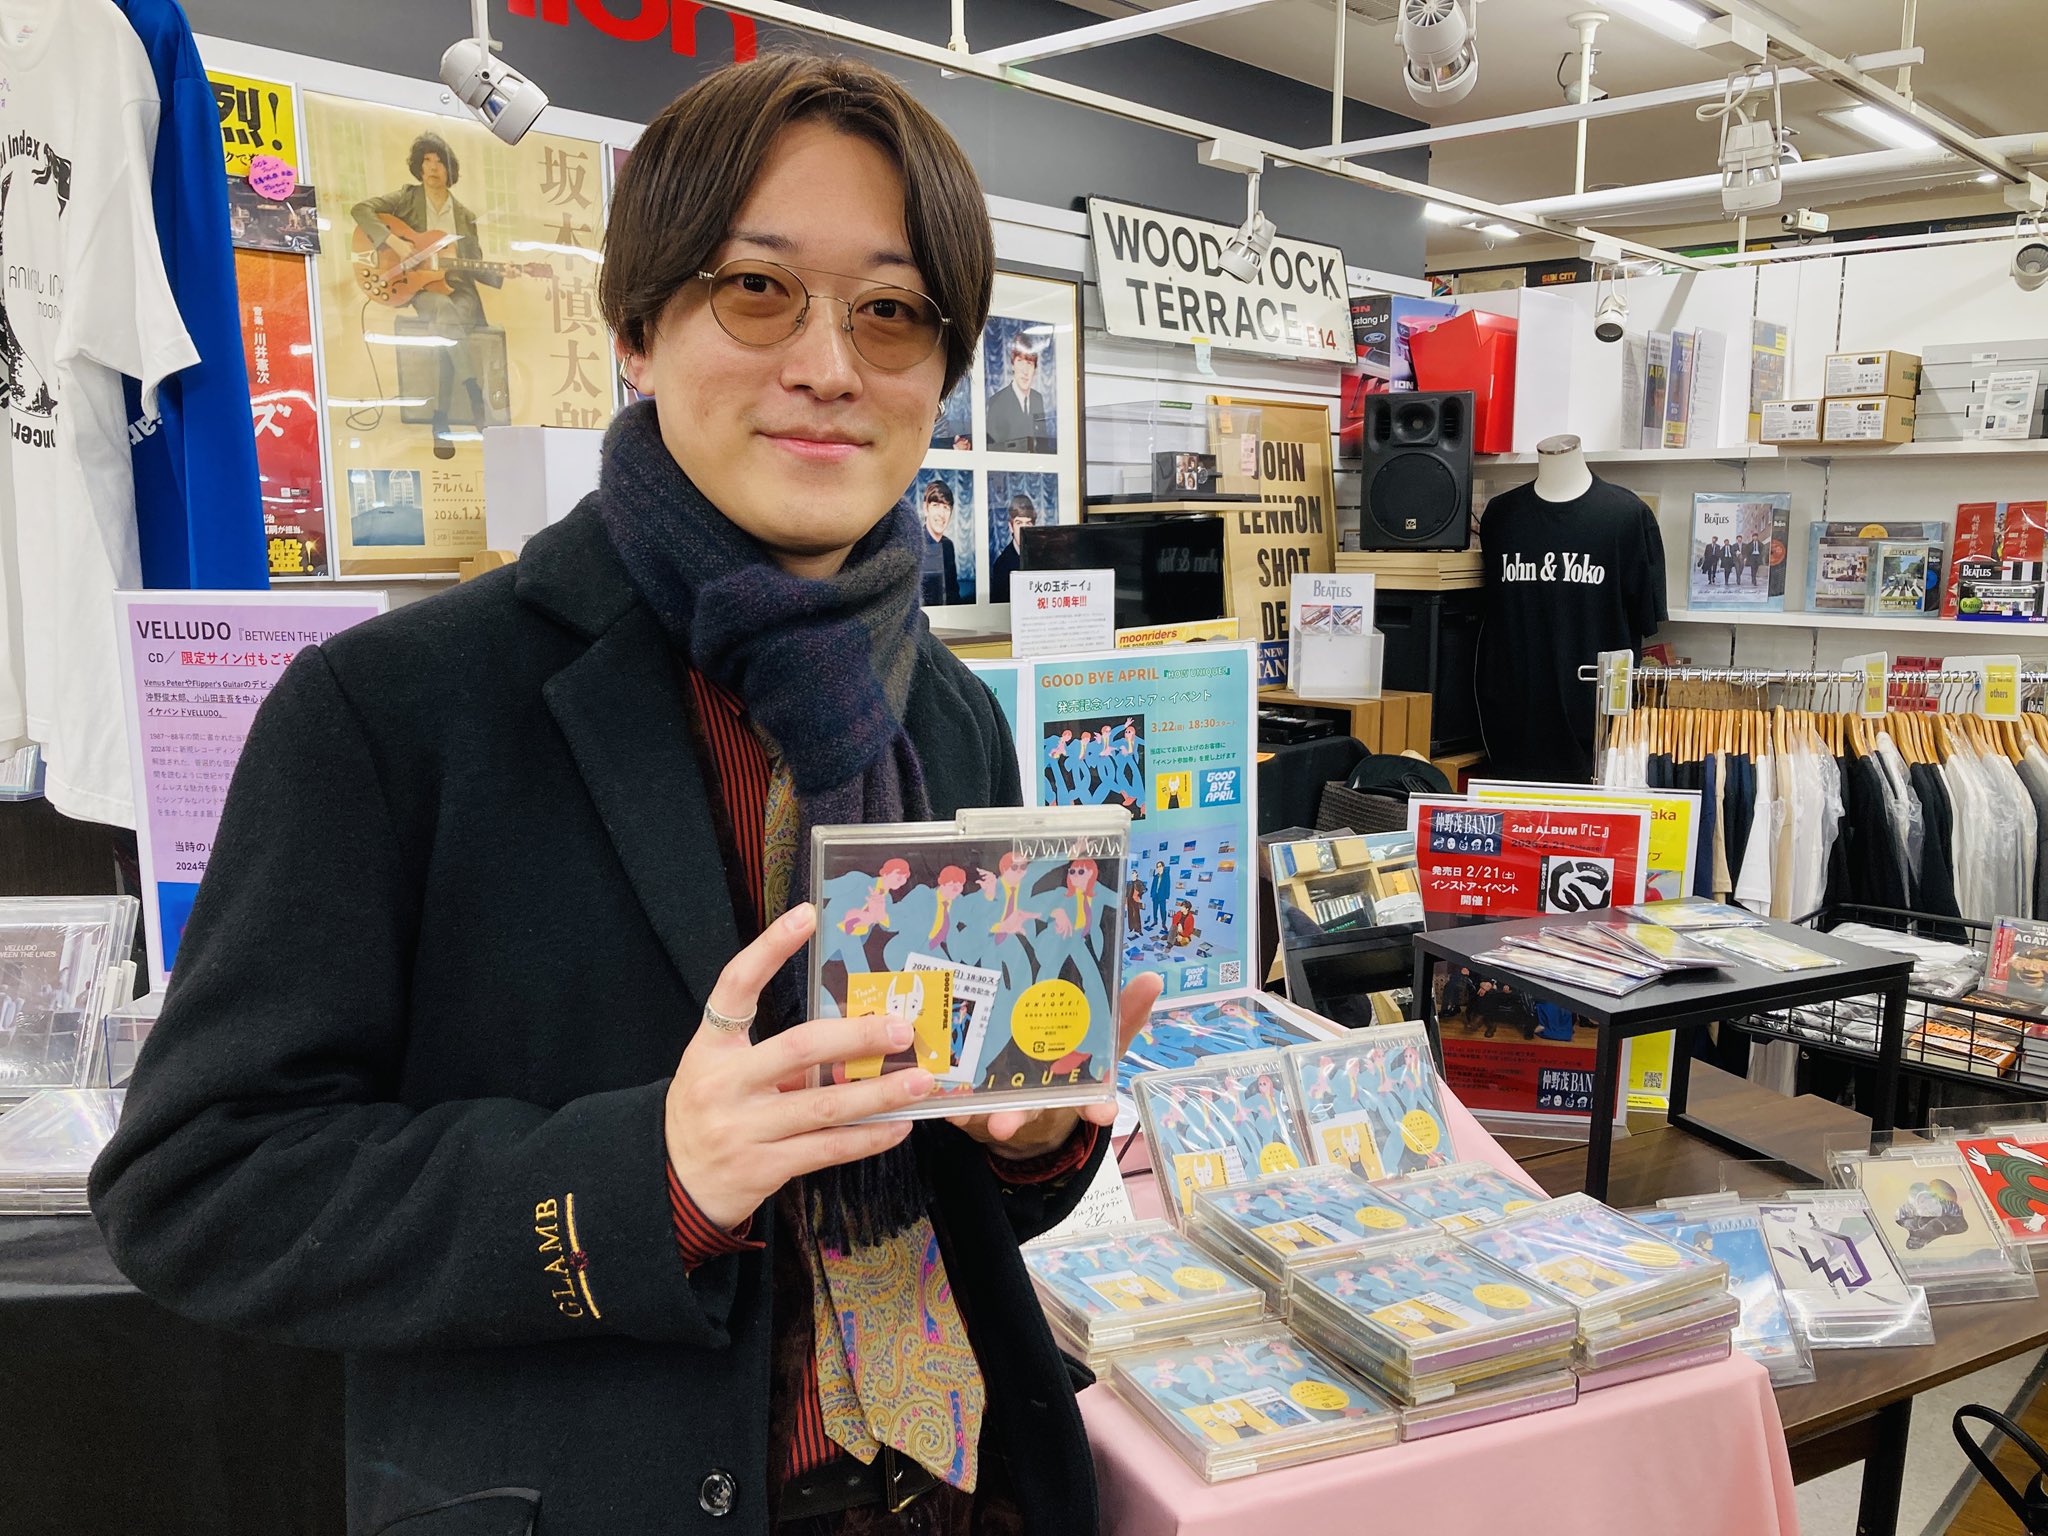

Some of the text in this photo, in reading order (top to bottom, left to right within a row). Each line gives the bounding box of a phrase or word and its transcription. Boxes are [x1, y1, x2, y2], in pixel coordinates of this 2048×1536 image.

[8, 130, 40, 160] Index
[1103, 212, 1341, 299] WOODOCK
[1559, 272, 1577, 281] CITY
[1126, 278, 1301, 345] TERRACE
[432, 470, 462, 479] ニュー
[433, 483, 473, 493] アルバム
[434, 506, 486, 520] 2026.1.2
[1502, 552, 1605, 584] John & Yoko
[1963, 565, 1992, 578] BEATLES
[1029, 580, 1091, 593] 『火の玉ボーイ』
[136, 621, 231, 640] VELLUDO
[297, 631, 318, 642] THE
[1119, 629, 1178, 644] moonriders
[144, 678, 165, 687] Venus
[1041, 673, 1084, 688] GOOD
[1087, 670, 1114, 685] BYE
[1118, 667, 1160, 682] APRIL
[1057, 689, 1212, 713] 発売記念インストア・イベント
[1989, 690, 2009, 699] others
[1206, 770, 1236, 783] GOOD
[1209, 781, 1232, 792] BYE
[1205, 791, 1236, 803] APRIL
[1511, 825, 1533, 834] 2nd
[1536, 826, 1577, 836] ALBUM
[1580, 824, 1610, 838] 『に』
[1432, 866, 1462, 876] 発売日
[1431, 880, 1519, 896] インストア・イベント
[534, 1197, 584, 1319] GLAMB
